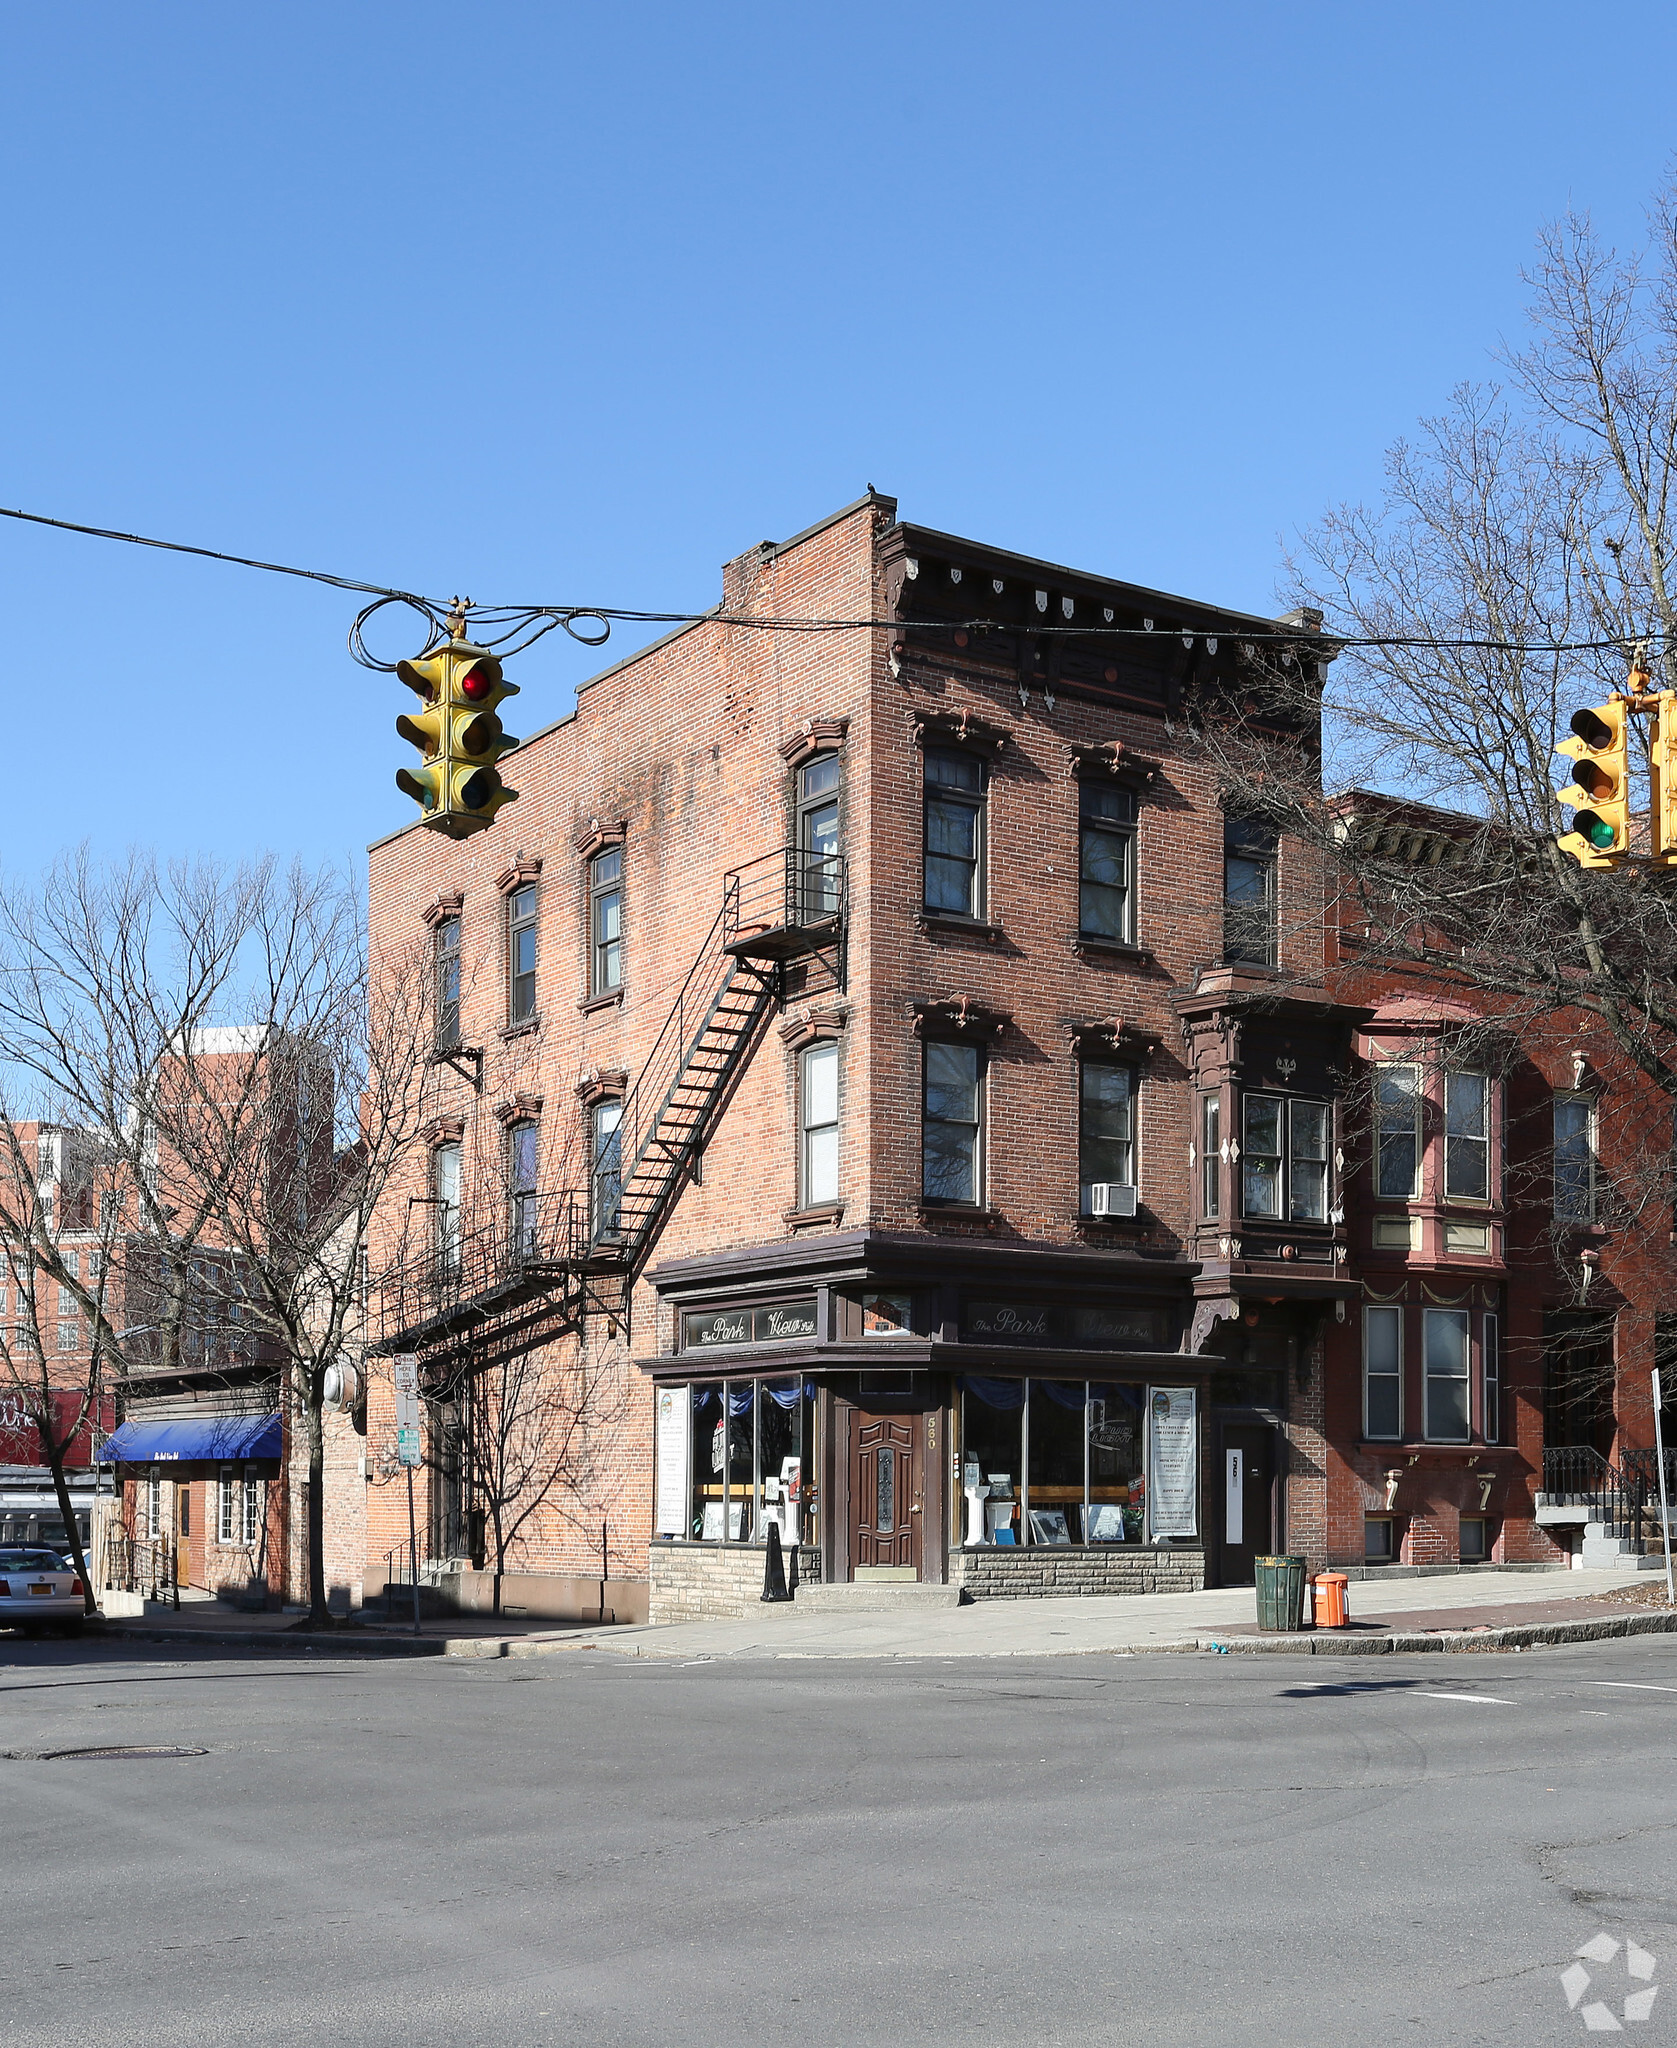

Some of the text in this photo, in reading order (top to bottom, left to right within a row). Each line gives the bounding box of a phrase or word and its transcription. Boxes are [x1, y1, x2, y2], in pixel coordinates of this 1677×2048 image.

[711, 1316, 745, 1341] Park
[768, 1310, 801, 1336] View
[975, 1319, 992, 1332] The
[993, 1308, 1047, 1335] Park
[1092, 1434, 1133, 1443] LIGHT
